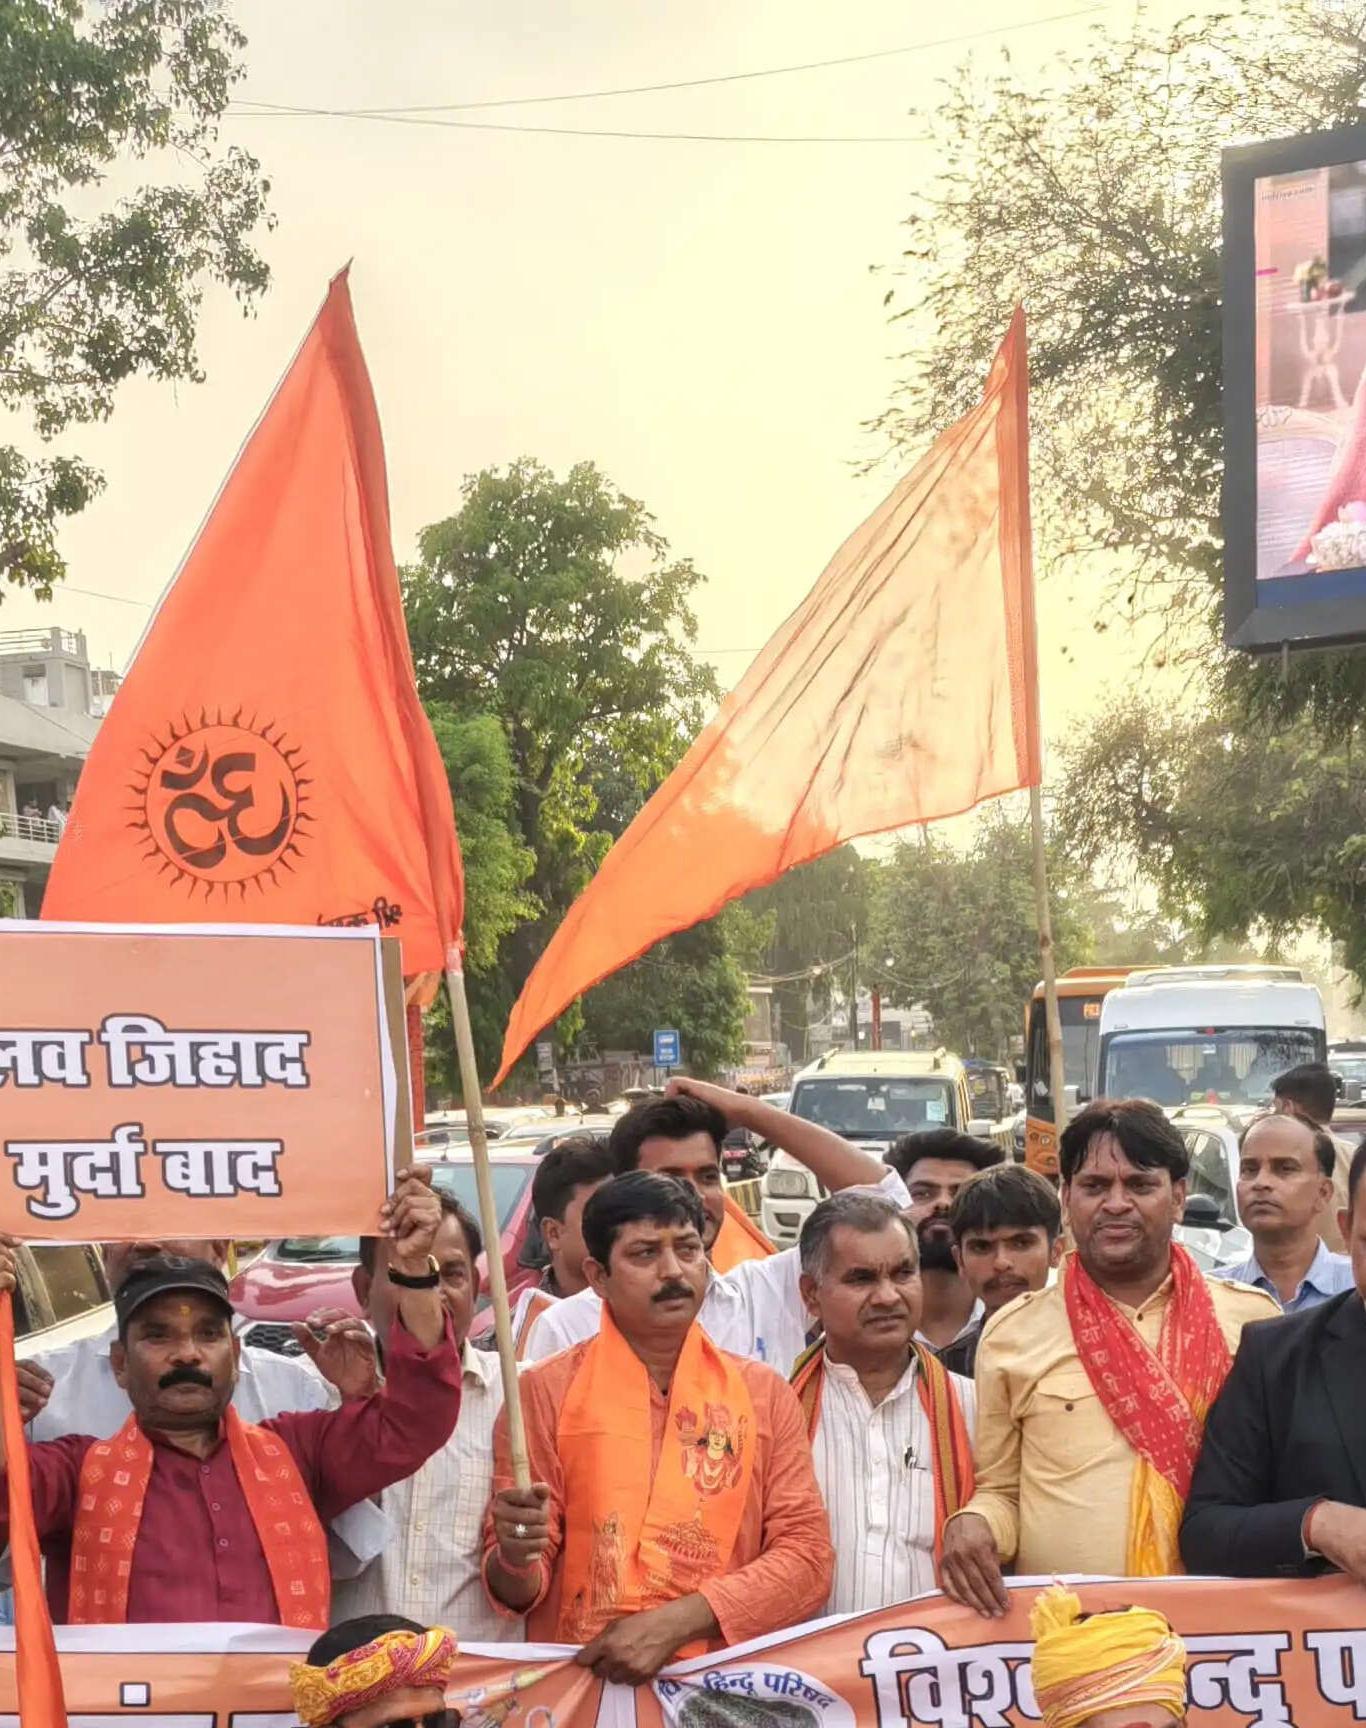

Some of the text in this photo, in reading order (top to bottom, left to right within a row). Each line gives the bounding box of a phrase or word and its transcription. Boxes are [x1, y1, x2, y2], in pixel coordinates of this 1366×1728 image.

[99, 1014, 312, 1090] जिहाद
[4, 1123, 283, 1221] मुर्दा बाद
[763, 1671, 836, 1710] परिषद
